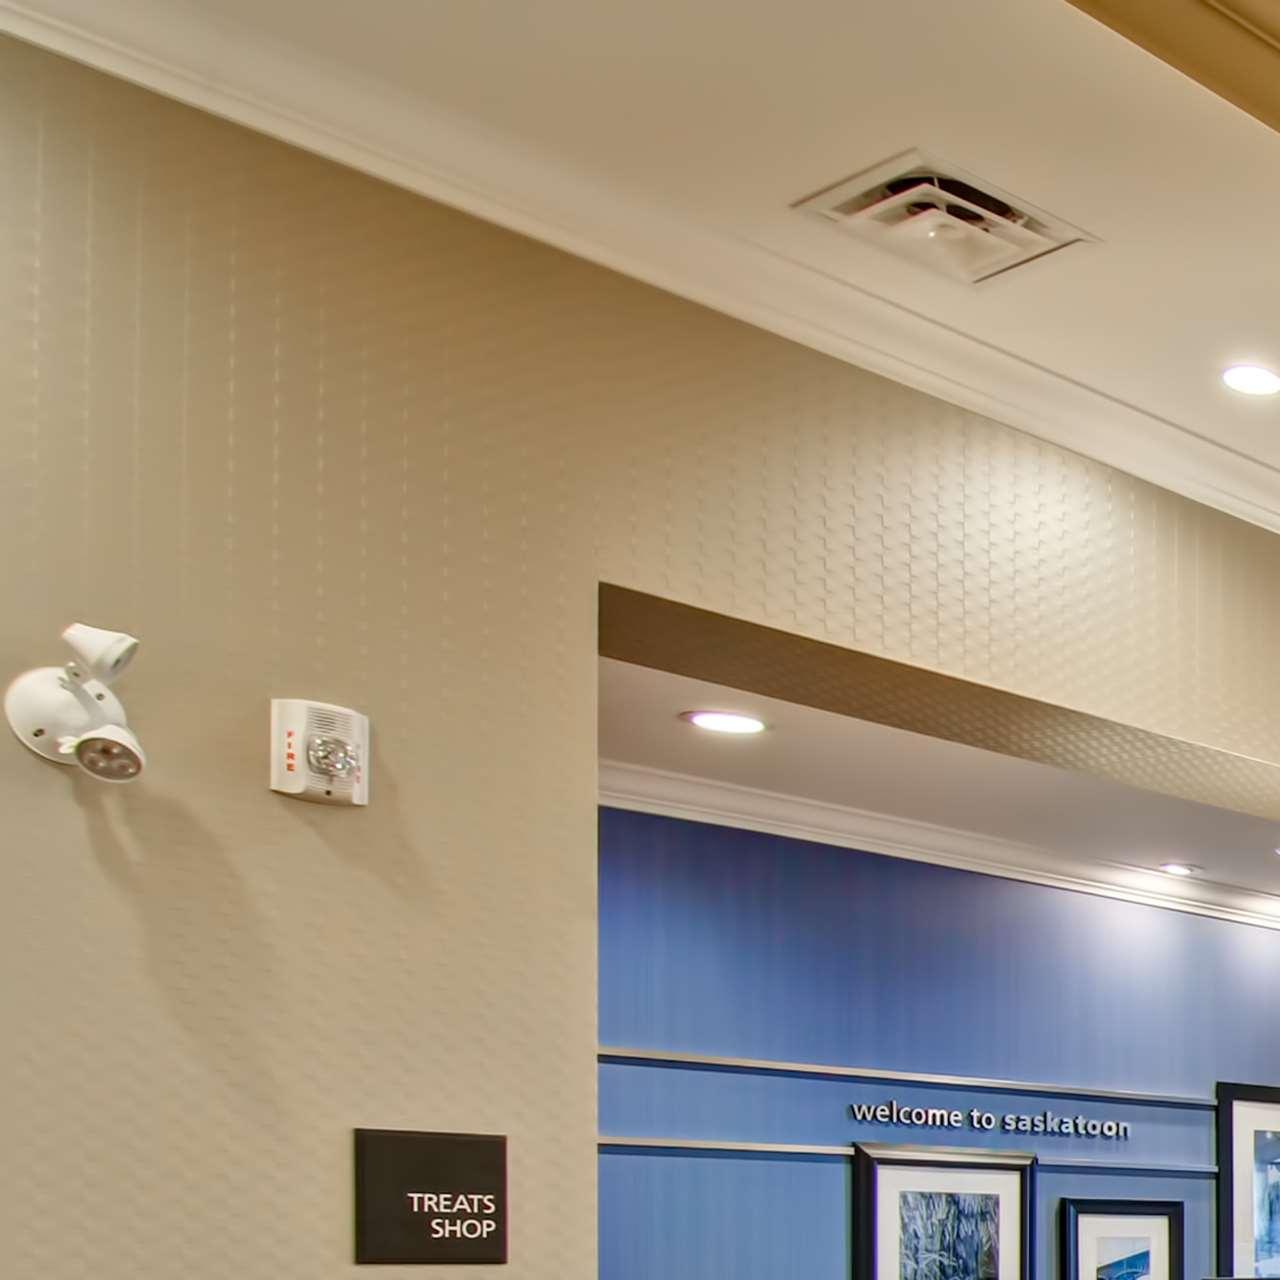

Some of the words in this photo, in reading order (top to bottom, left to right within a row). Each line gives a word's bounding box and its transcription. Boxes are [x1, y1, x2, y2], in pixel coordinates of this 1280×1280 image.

[851, 1100, 963, 1128] welcome
[970, 1108, 996, 1130] to
[1003, 1111, 1131, 1138] saskatoon
[407, 1193, 497, 1214] TREATS
[430, 1219, 497, 1239] SHOP
